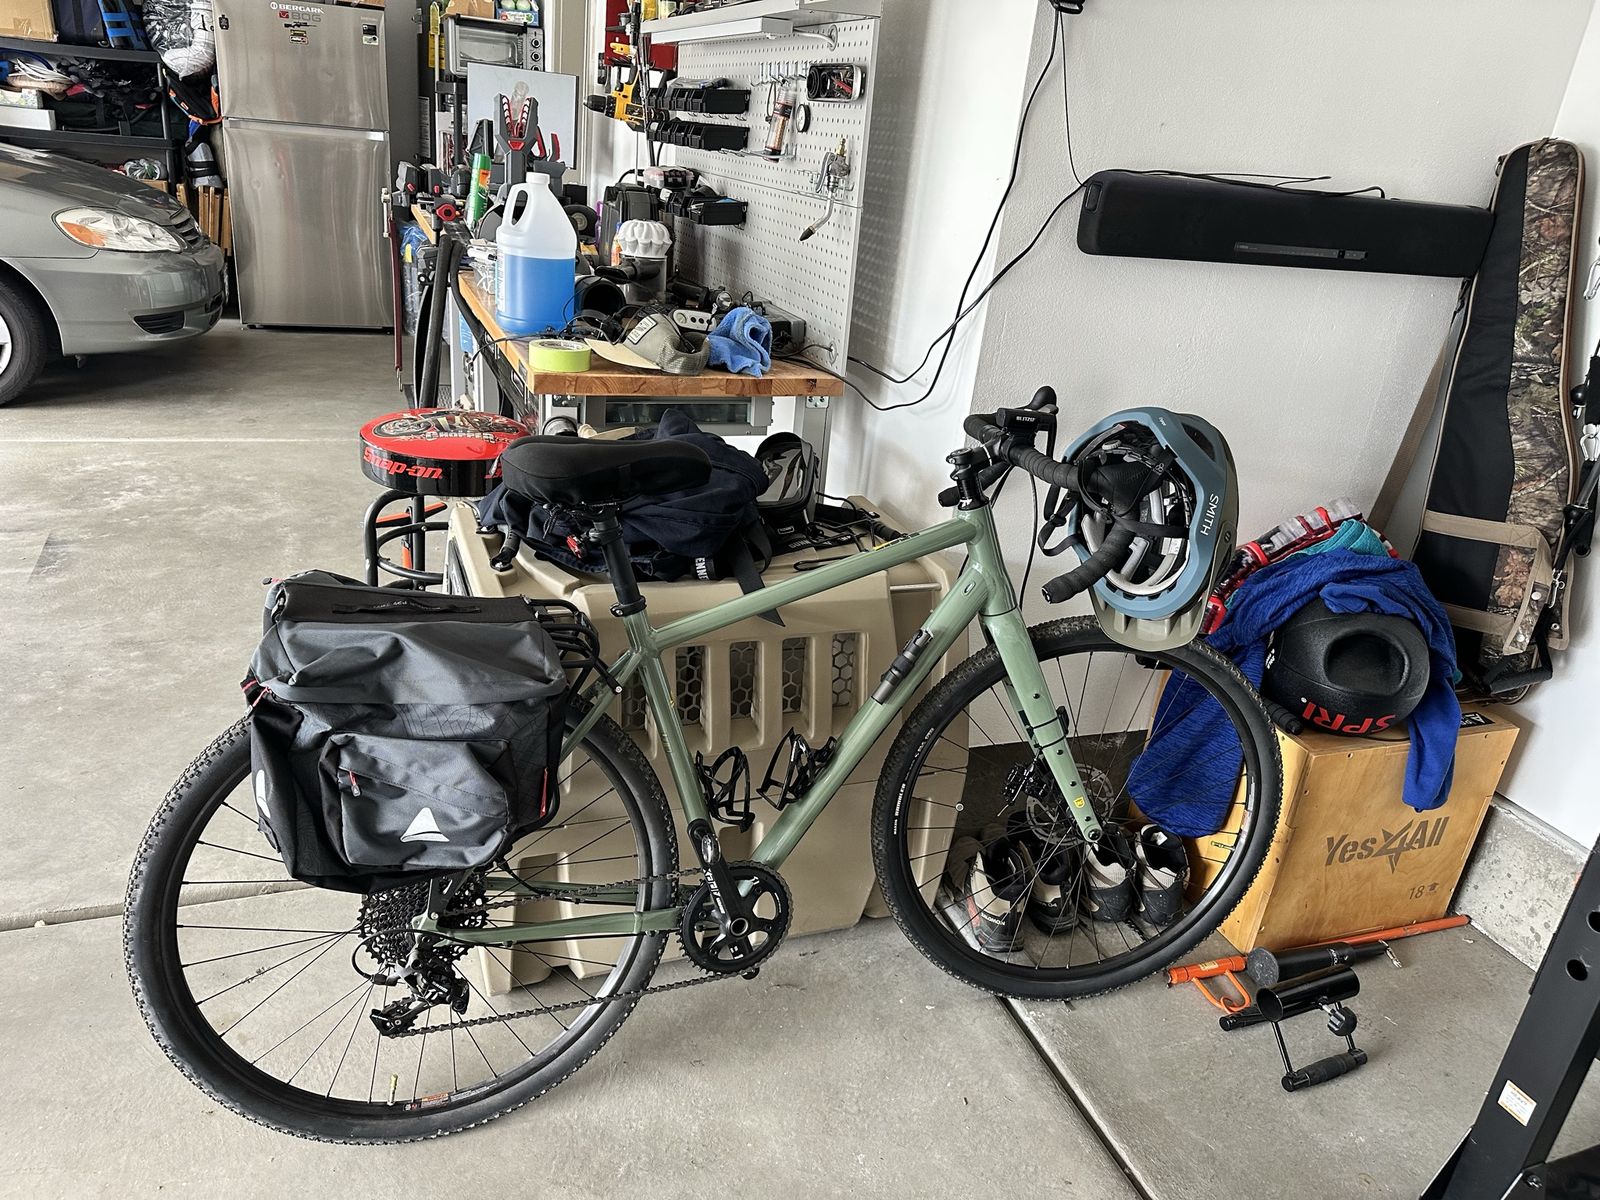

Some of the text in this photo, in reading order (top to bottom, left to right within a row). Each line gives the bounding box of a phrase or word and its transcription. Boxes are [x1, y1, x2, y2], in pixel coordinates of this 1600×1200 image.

[363, 446, 442, 479] Snap-on
[1200, 493, 1219, 536] SMITH
[1302, 702, 1396, 734] SPRI
[1325, 816, 1450, 874] Yes4All
[1409, 885, 1425, 900] 18
